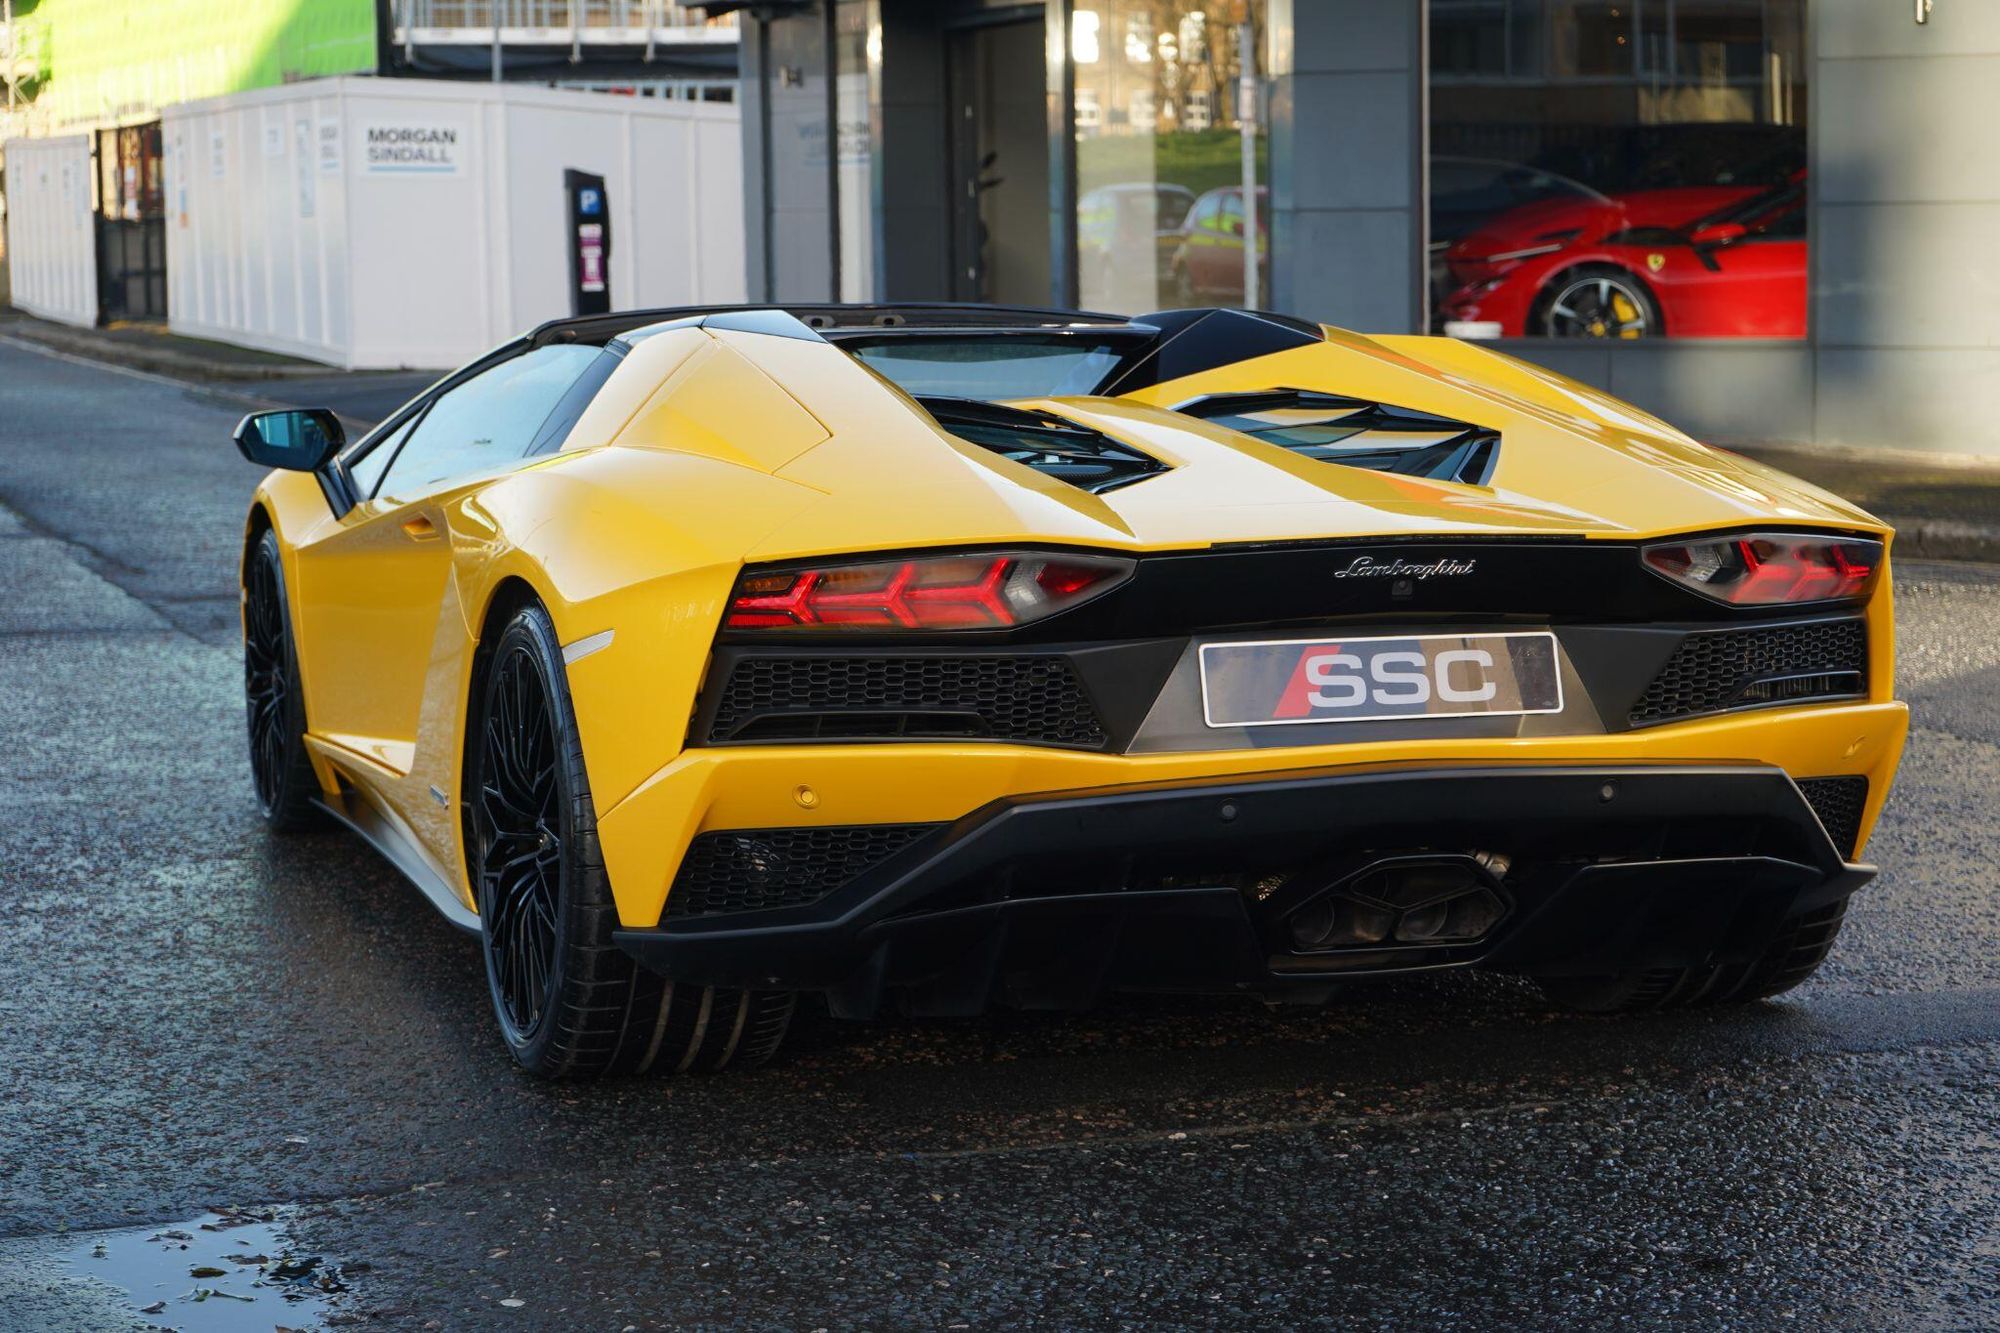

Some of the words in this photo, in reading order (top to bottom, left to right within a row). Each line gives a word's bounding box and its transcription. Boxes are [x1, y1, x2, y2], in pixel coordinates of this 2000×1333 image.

[368, 128, 457, 144] MORGAN
[368, 147, 453, 162] SINDALL
[580, 189, 599, 213] P
[1334, 556, 1476, 579] Lamborghini
[1305, 649, 1496, 708] SSC
